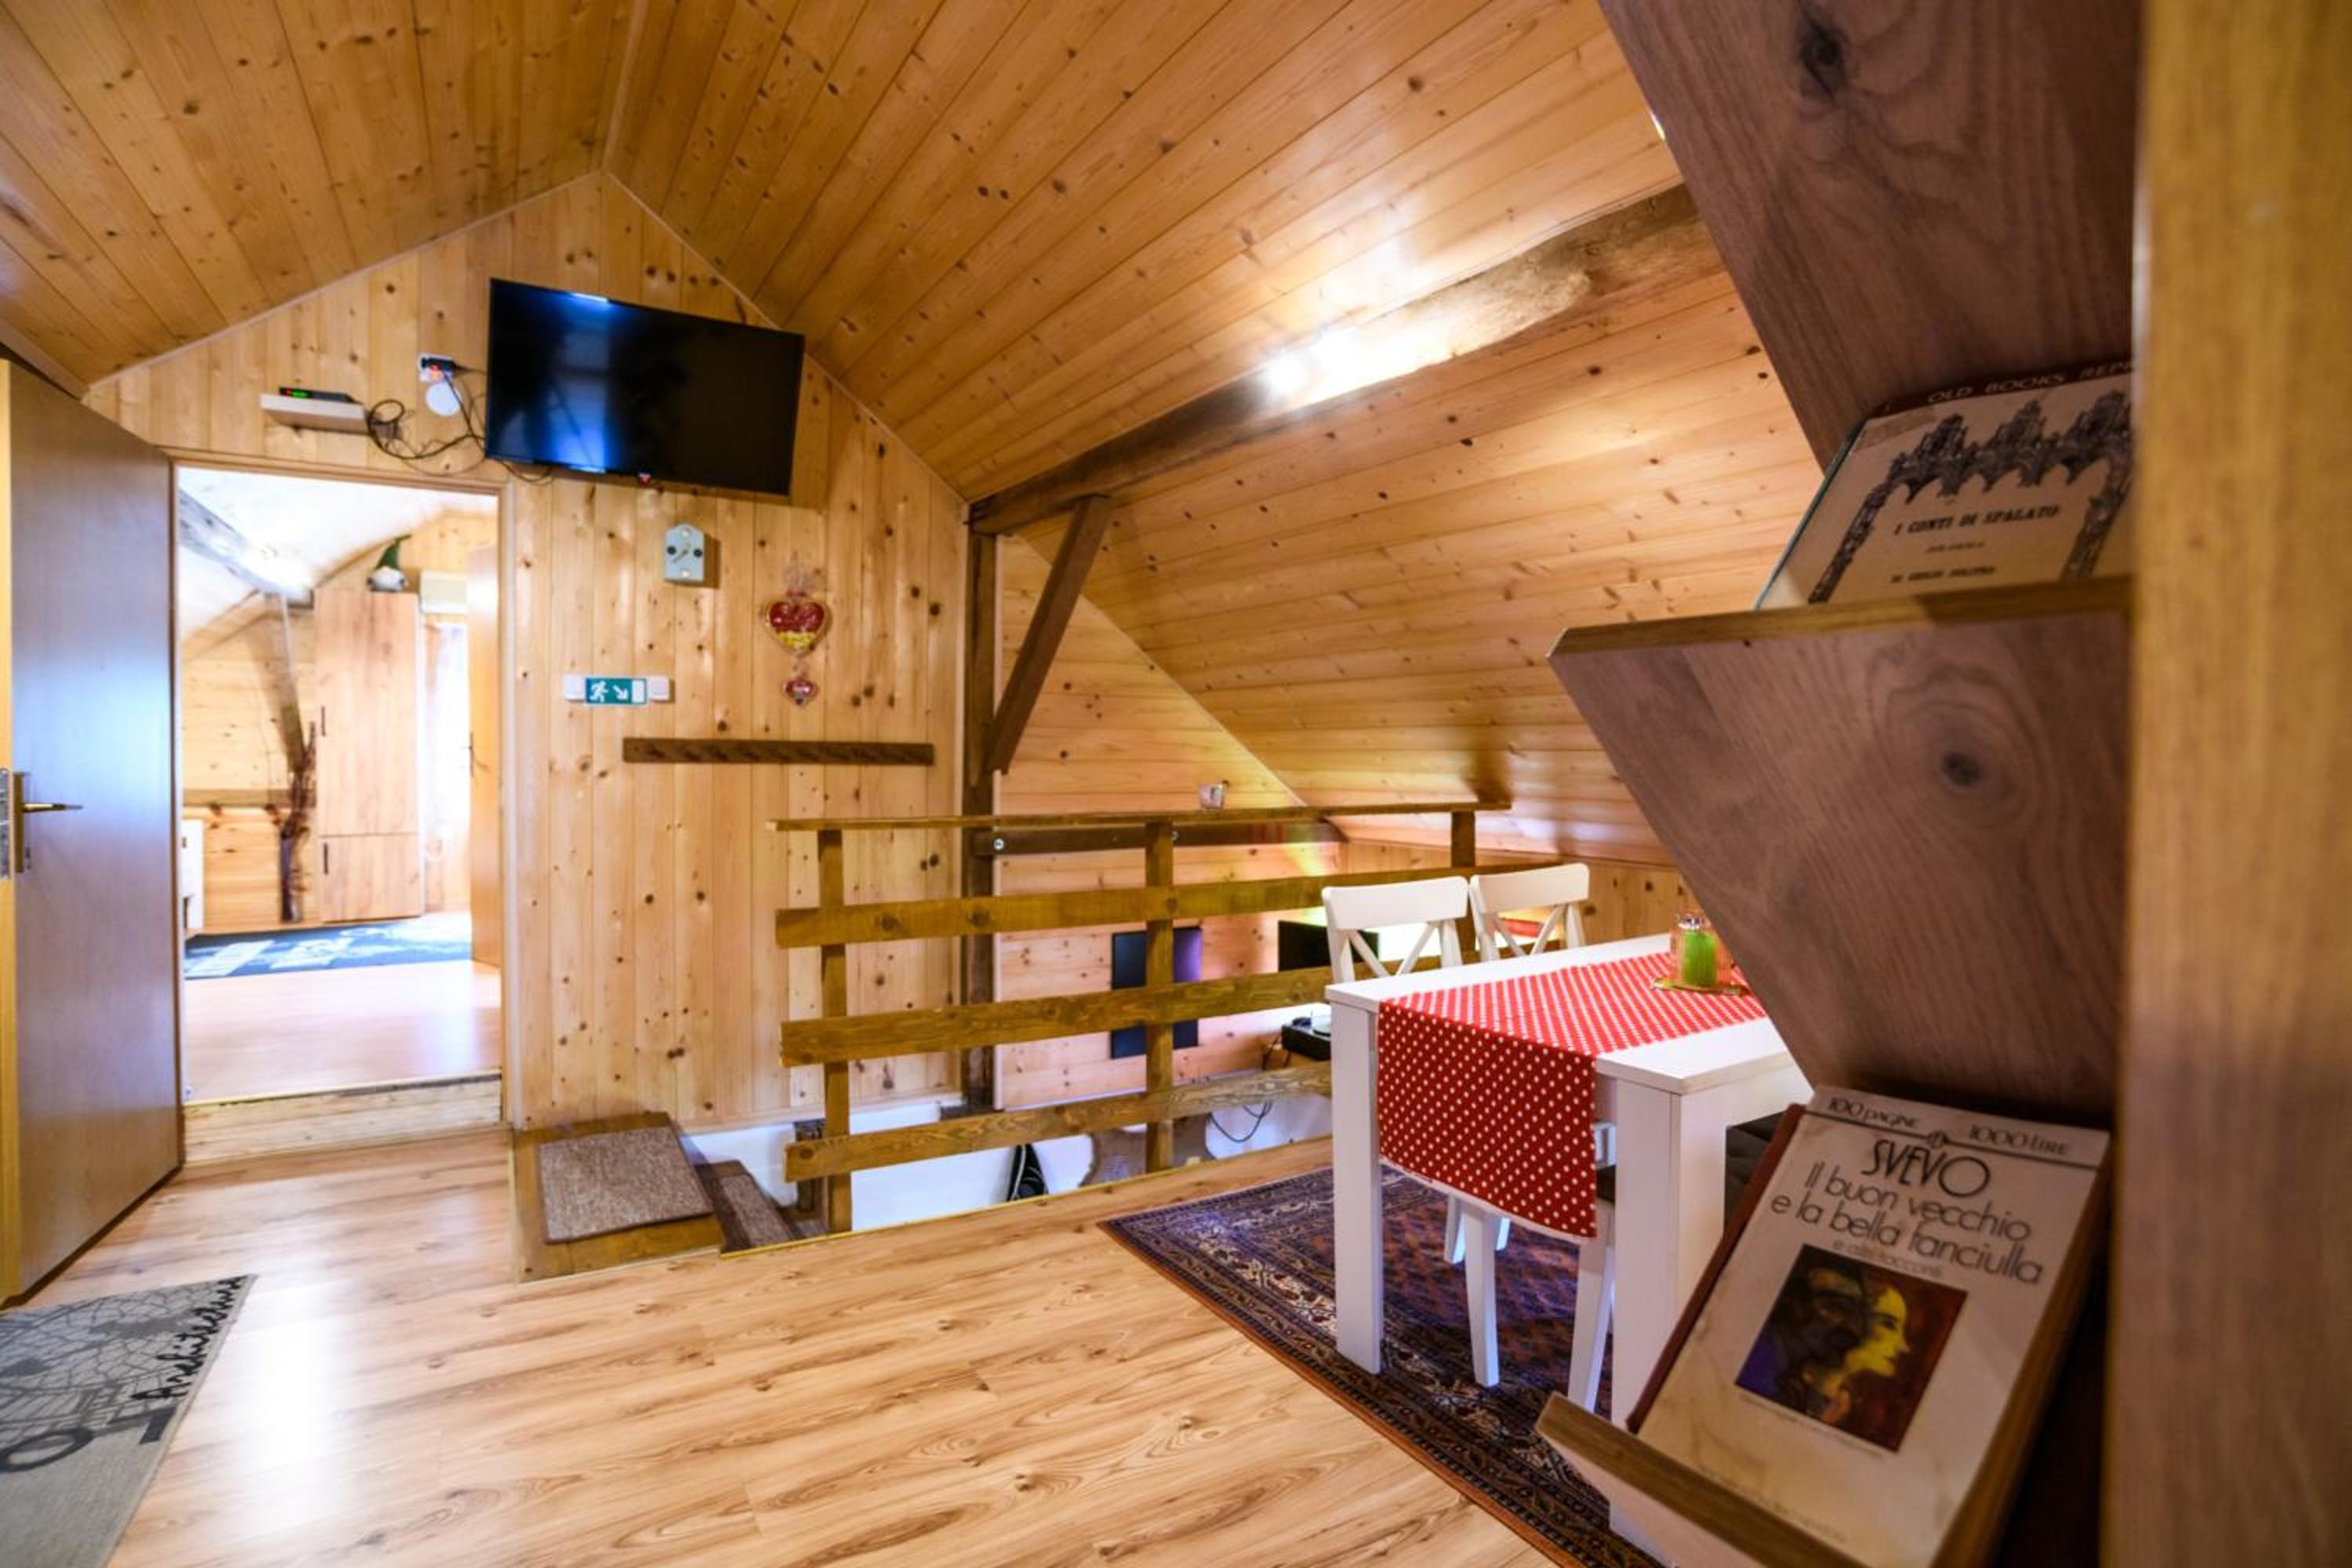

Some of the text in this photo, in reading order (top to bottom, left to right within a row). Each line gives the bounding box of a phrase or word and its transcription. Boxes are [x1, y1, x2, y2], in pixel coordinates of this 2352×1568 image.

[1928, 387, 1973, 403] OLD
[1986, 374, 2066, 394] BOOKS
[1893, 505, 2060, 535] I CONTI DI SPALATO
[1828, 1098, 1864, 1117] 100
[1969, 1124, 2026, 1147] 1000
[1860, 1139, 1991, 1197] SVEVO
[1805, 1161, 2031, 1243] Il buon vecchio
[1770, 1192, 2044, 1283] e la bella fanciulla
